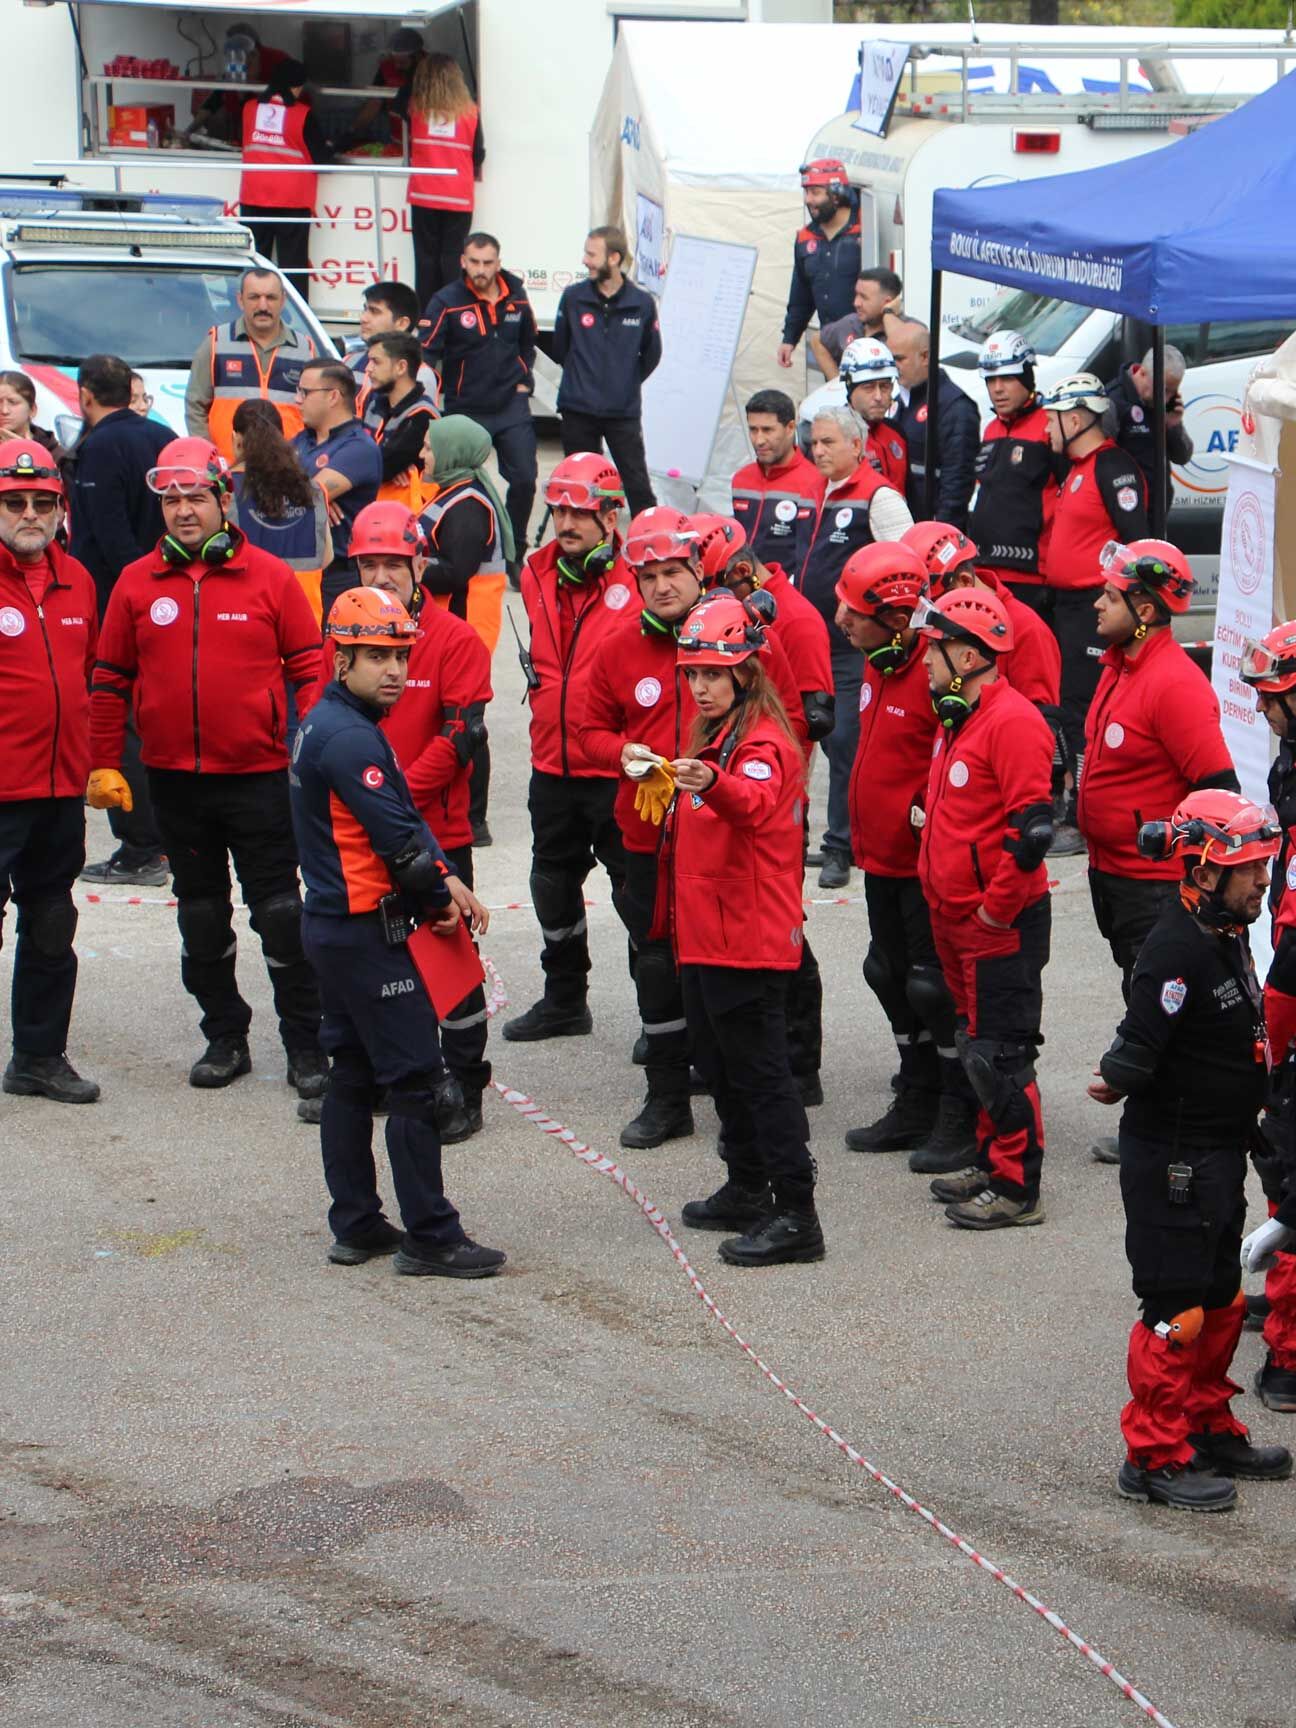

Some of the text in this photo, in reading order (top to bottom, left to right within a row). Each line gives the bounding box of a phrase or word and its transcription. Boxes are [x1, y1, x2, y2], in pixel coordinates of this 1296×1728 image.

[354, 208, 413, 232] BOL
[951, 232, 970, 258] BOLU
[981, 239, 1000, 265] AFET
[1000, 243, 1013, 268] VE
[1014, 241, 1033, 273] ACİL
[1034, 252, 1066, 280] DURUM
[1066, 252, 1124, 292] MÜDÜRLÜĞÜ
[1206, 430, 1240, 453] AF
[382, 979, 415, 998] AFAD
